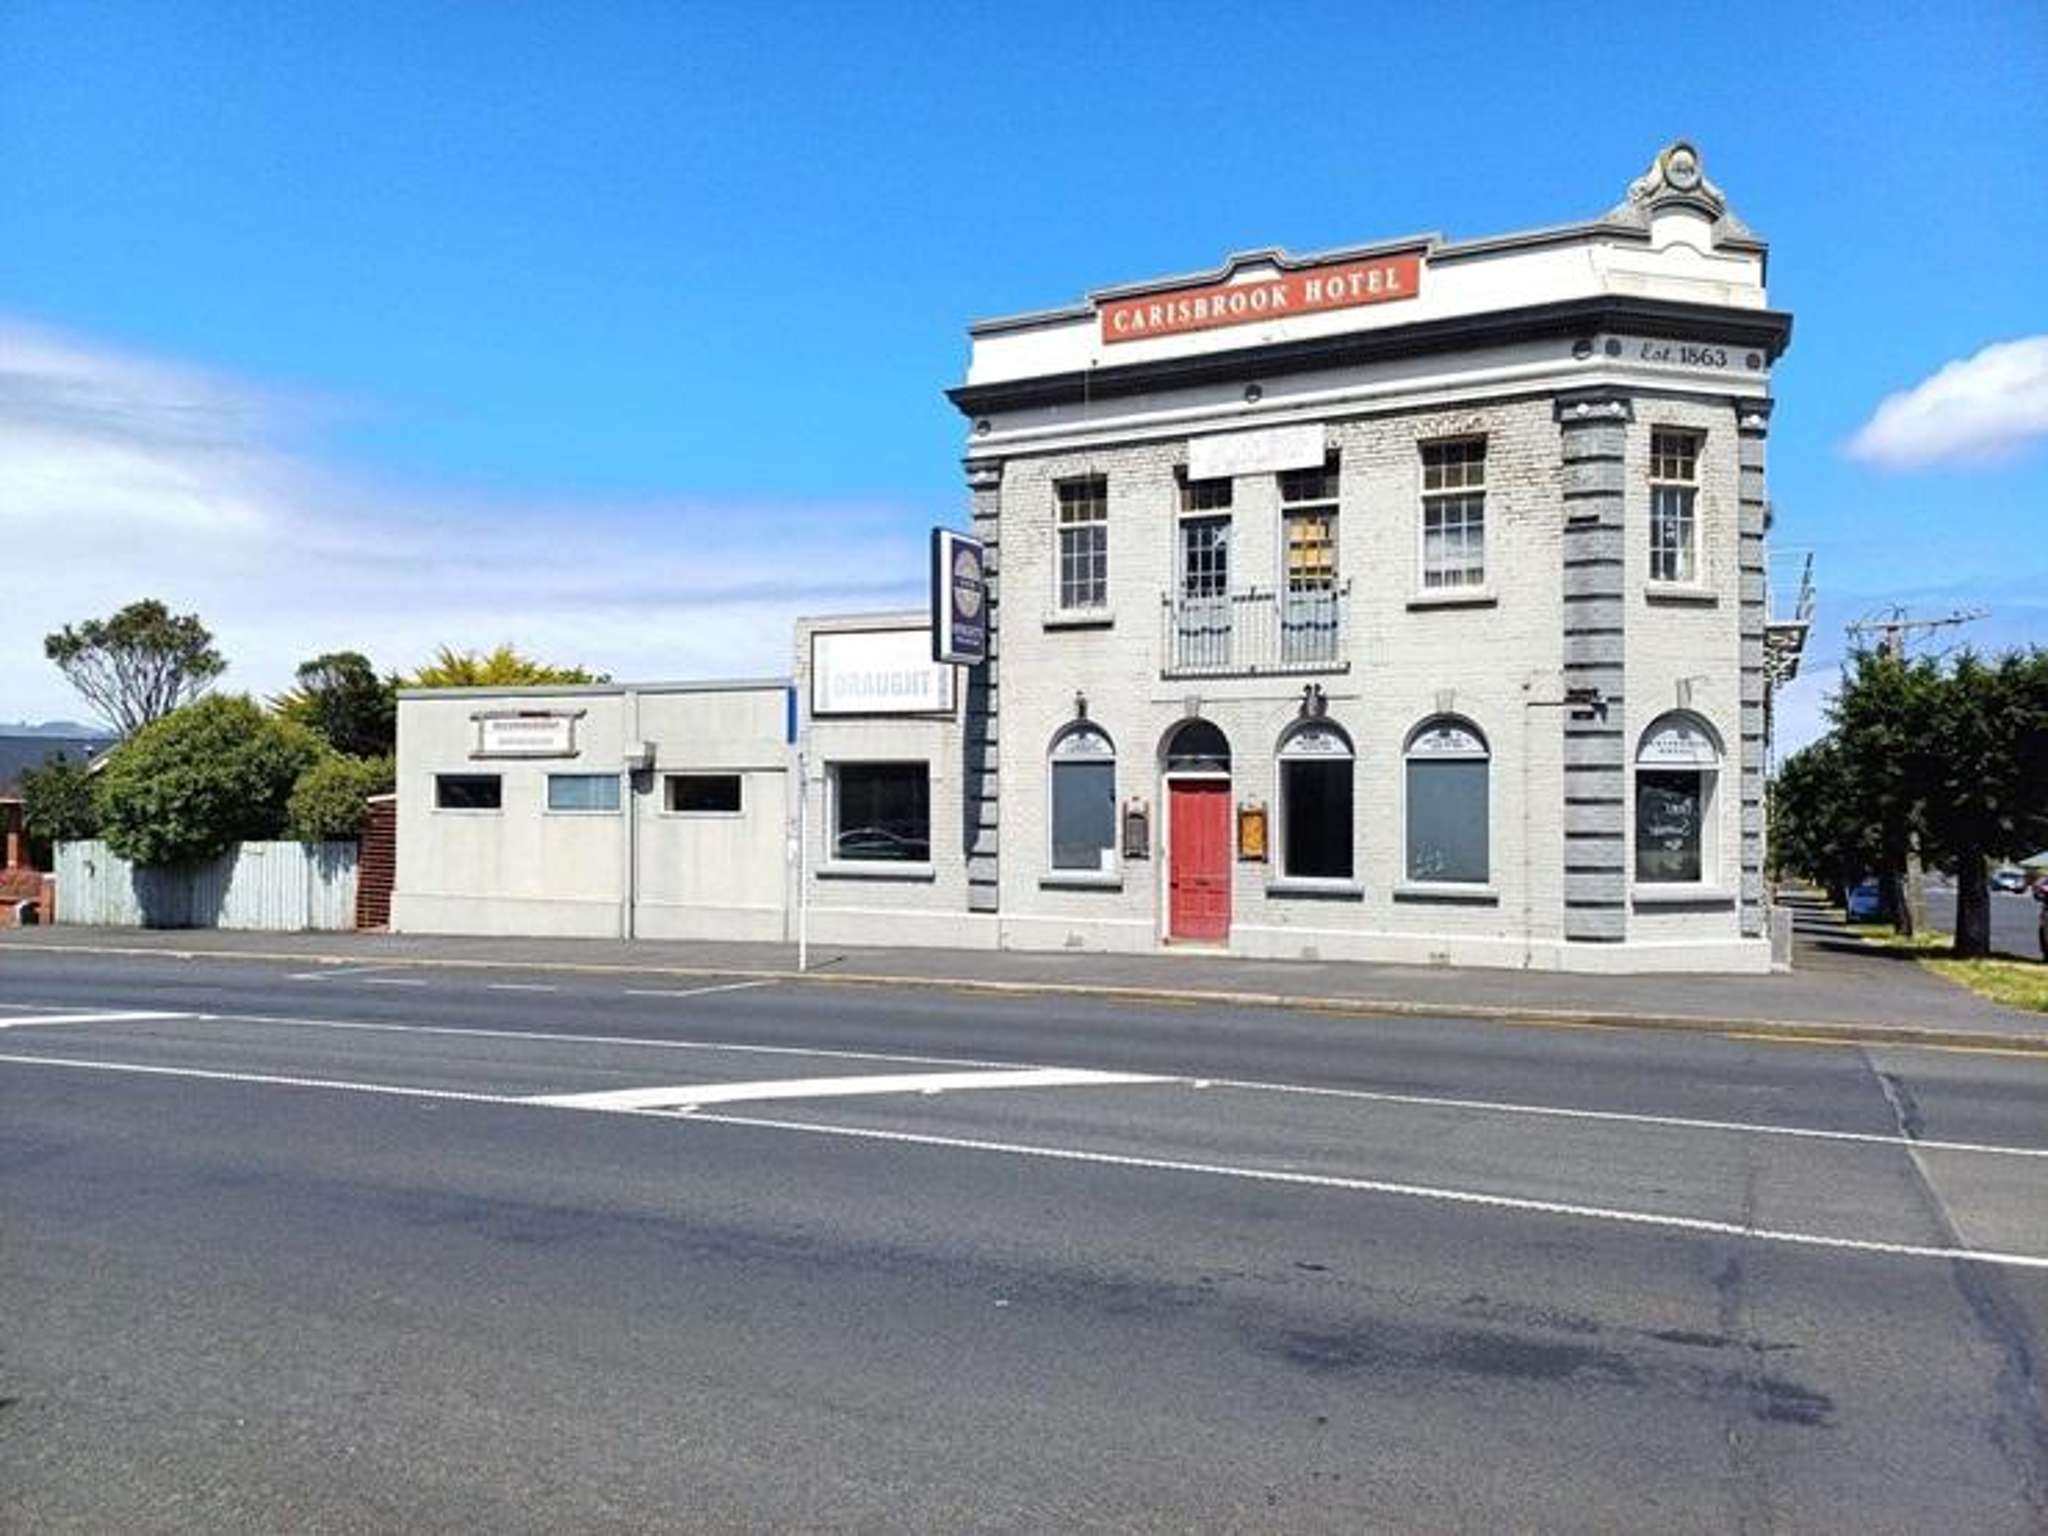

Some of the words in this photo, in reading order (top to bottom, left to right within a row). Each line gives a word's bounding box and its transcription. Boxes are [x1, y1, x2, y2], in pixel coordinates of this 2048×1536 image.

[1113, 284, 1289, 332] CARISBROOK
[1305, 267, 1400, 301] HOTEL
[1681, 345, 1728, 368] 1863
